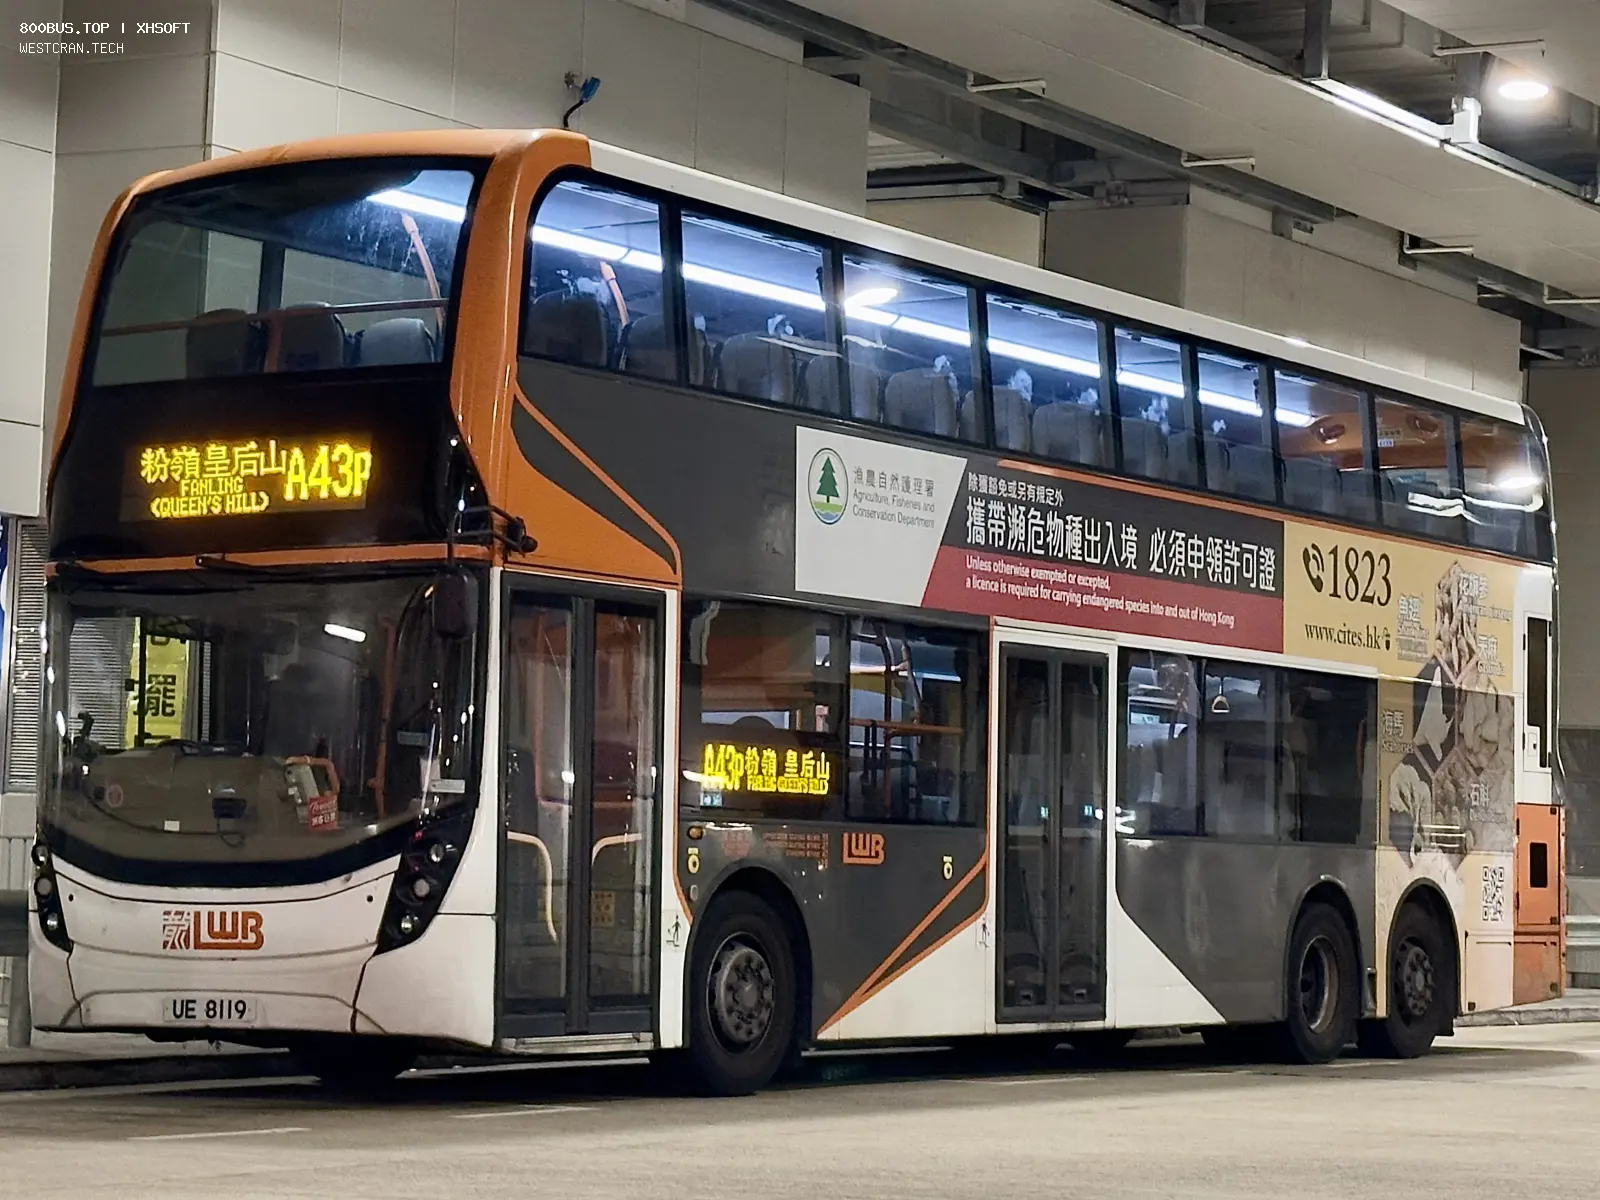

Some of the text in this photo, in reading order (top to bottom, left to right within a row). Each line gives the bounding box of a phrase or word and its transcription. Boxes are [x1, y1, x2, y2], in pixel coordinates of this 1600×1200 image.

[140, 439, 287, 484] 粉嶺皇后山
[284, 442, 373, 501] A43P
[180, 477, 244, 497] FANLING
[853, 466, 935, 497] 漁農自然護理署
[852, 504, 935, 529] Conservation Department
[892, 494, 921, 511] Fisheries
[923, 501, 935, 513] and
[966, 495, 1276, 592] 攜帶瀕危物種出入境 必須申領許可證
[966, 554, 1111, 591] Unless otherwise exempted or excepted,
[1328, 544, 1392, 607] 1823
[965, 574, 1235, 629] a licence is required for carrying endangered species into and out of Hong Kong
[1304, 622, 1381, 650] www.cites.hk
[704, 743, 745, 791] A43P
[784, 749, 830, 781] 皇后山
[842, 832, 885, 865] LWB
[193, 911, 264, 950] LWB
[172, 999, 247, 1019] UE 8119
